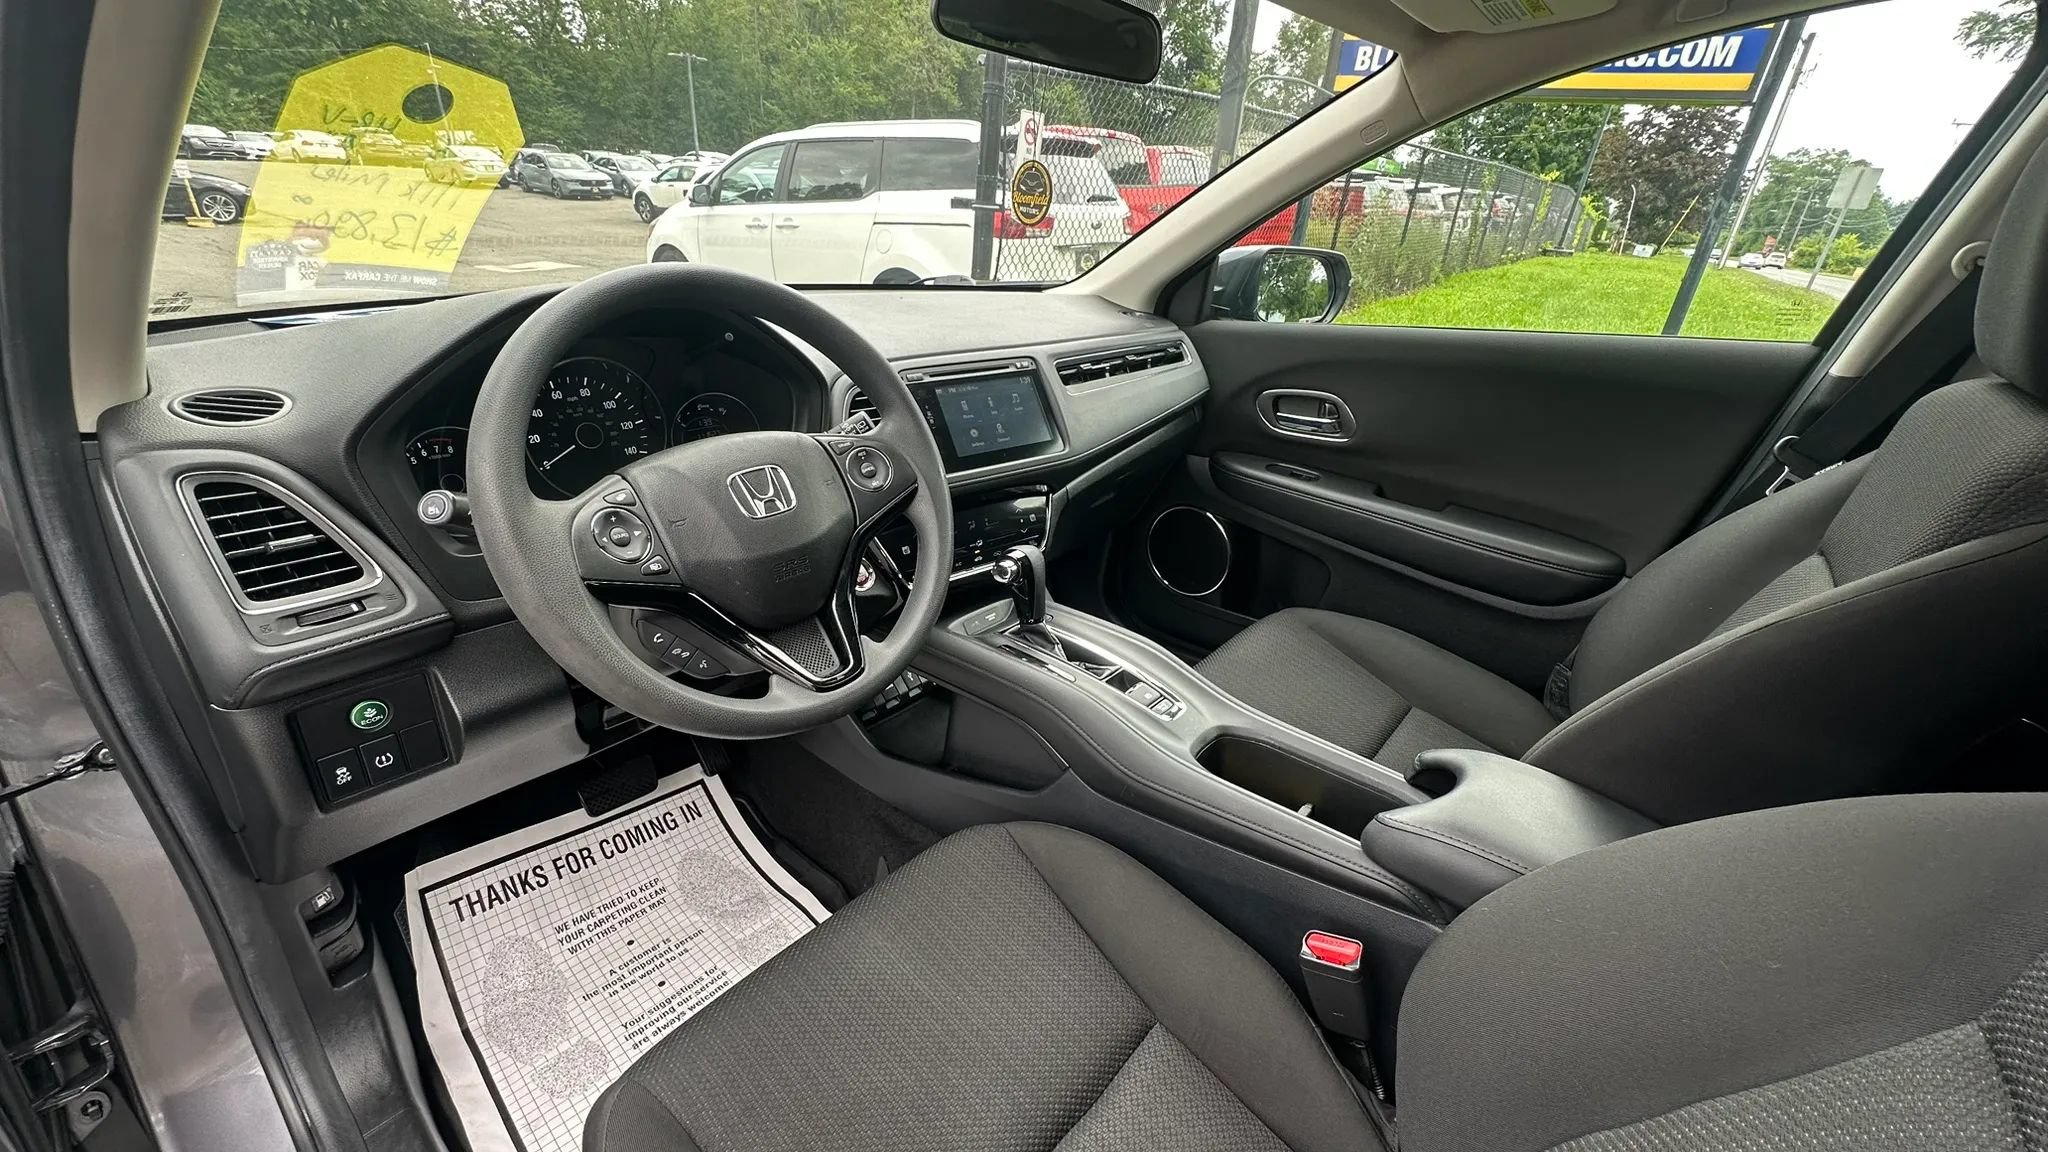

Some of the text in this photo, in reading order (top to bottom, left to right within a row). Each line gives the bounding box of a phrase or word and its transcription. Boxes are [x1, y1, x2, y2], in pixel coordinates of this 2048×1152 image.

[1604, 35, 1744, 68] .COM
[1013, 191, 1049, 207] Bloomfield
[1020, 206, 1040, 215] MOTORS
[551, 390, 563, 400] 60
[580, 387, 591, 397] 80
[602, 400, 617, 410] 100
[532, 408, 543, 418] 40
[620, 421, 634, 430] 120
[528, 434, 541, 444] 20
[421, 449, 428, 457] 6
[434, 445, 439, 453] 7
[447, 445, 454, 454] 8
[624, 446, 638, 456] 140
[410, 457, 417, 465] 5
[360, 714, 384, 726] ECON
[336, 775, 353, 786] OFF
[449, 800, 703, 922] THANKS FOR COMING IN
[554, 877, 660, 935] WE HAVE TRIED TO KEEP
[558, 886, 667, 947] YOUR CARPETING CLEAN
[567, 897, 667, 955] WITH THIS PAPER MAT
[609, 937, 672, 977] A customer is
[582, 928, 705, 1002] the most important person
[608, 988, 620, 998] in
[620, 978, 637, 991] the
[638, 960, 666, 981] world
[666, 955, 677, 964] to
[621, 964, 719, 1031] Your suggestions for
[624, 968, 728, 1042] improving our service
[631, 1034, 650, 1051] are
[651, 1009, 687, 1038] always
